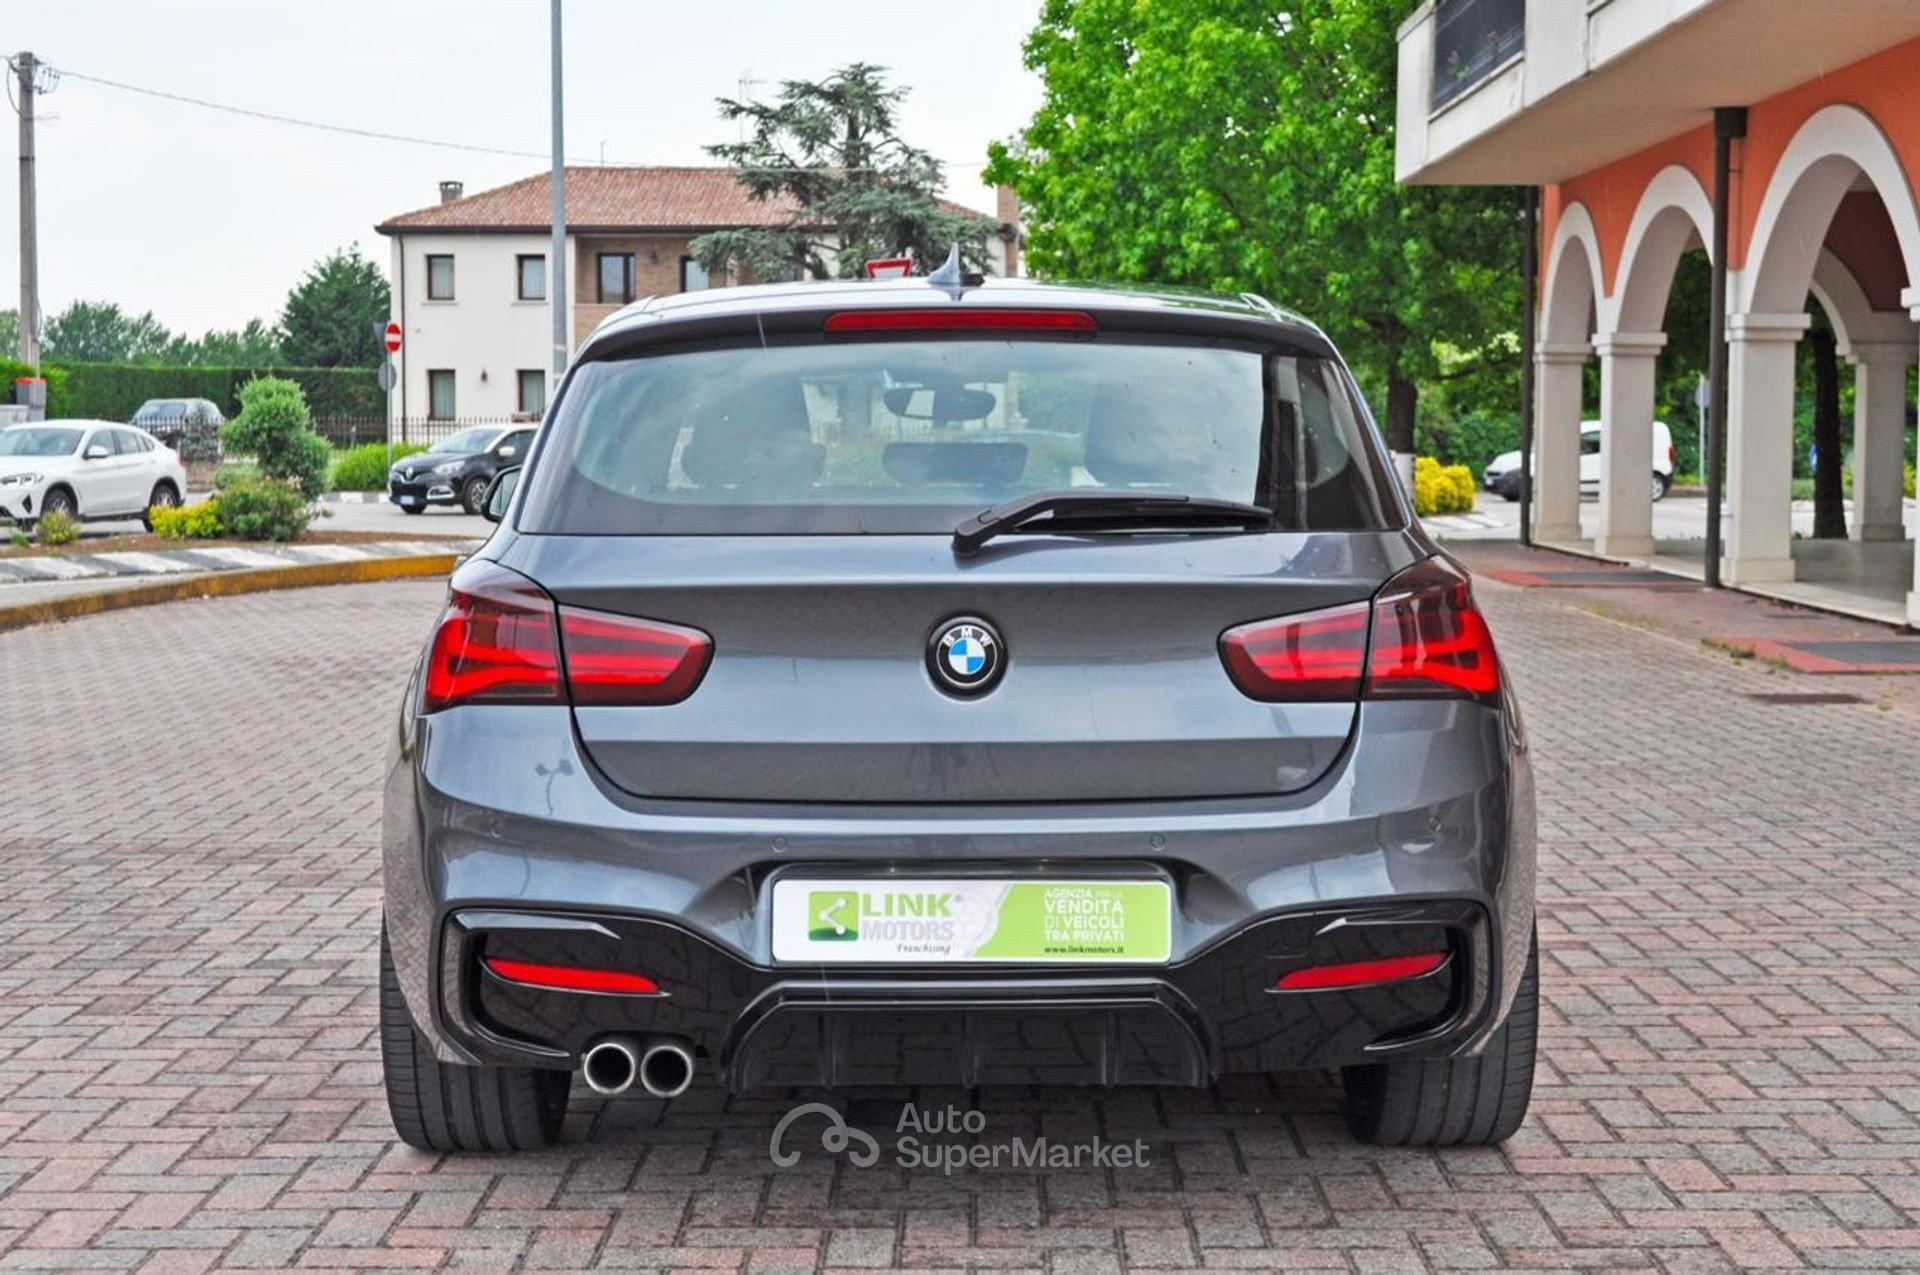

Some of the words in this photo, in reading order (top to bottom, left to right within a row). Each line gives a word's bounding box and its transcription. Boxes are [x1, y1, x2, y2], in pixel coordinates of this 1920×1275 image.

[943, 626, 992, 648] BMW
[1044, 888, 1092, 897] AGENZIA
[862, 892, 952, 917] LINK
[1044, 899, 1124, 913] VENDITA
[1045, 915, 1059, 929] DI
[1063, 915, 1124, 929] VEICOLI
[862, 921, 955, 941] MOTORS
[1044, 930, 1070, 941] TRA
[1073, 930, 1124, 941] PRIVATI
[1044, 945, 1124, 953] www.linkmotors.it
